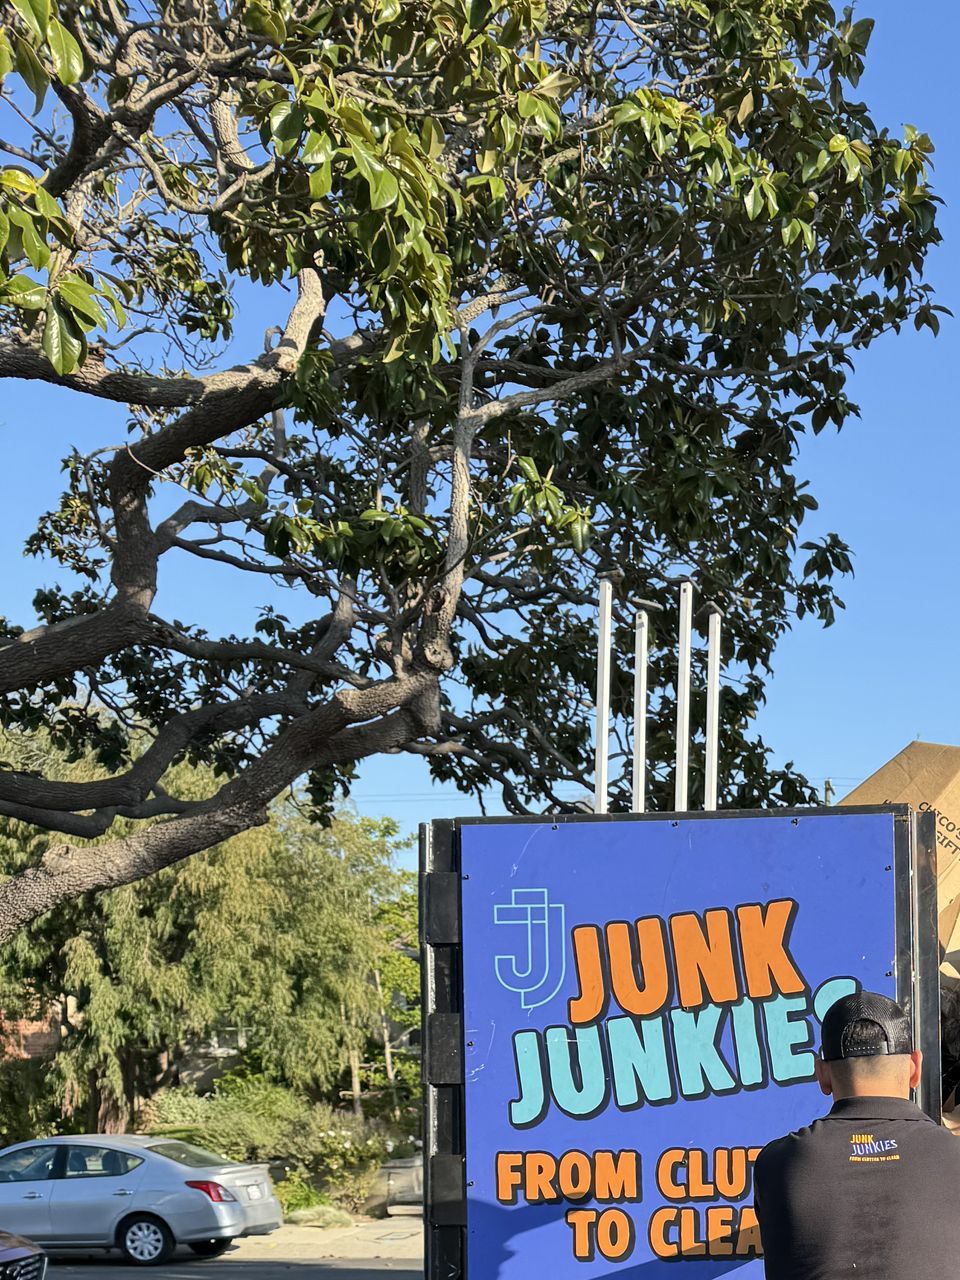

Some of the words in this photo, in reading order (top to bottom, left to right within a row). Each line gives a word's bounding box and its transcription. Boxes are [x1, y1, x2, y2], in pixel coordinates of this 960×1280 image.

[567, 897, 808, 1027] JUNK
[850, 1134, 873, 1144] JUNK
[851, 1139, 898, 1156] JUNKIES
[496, 1149, 643, 1205] FROM
[565, 1206, 636, 1263] TO
